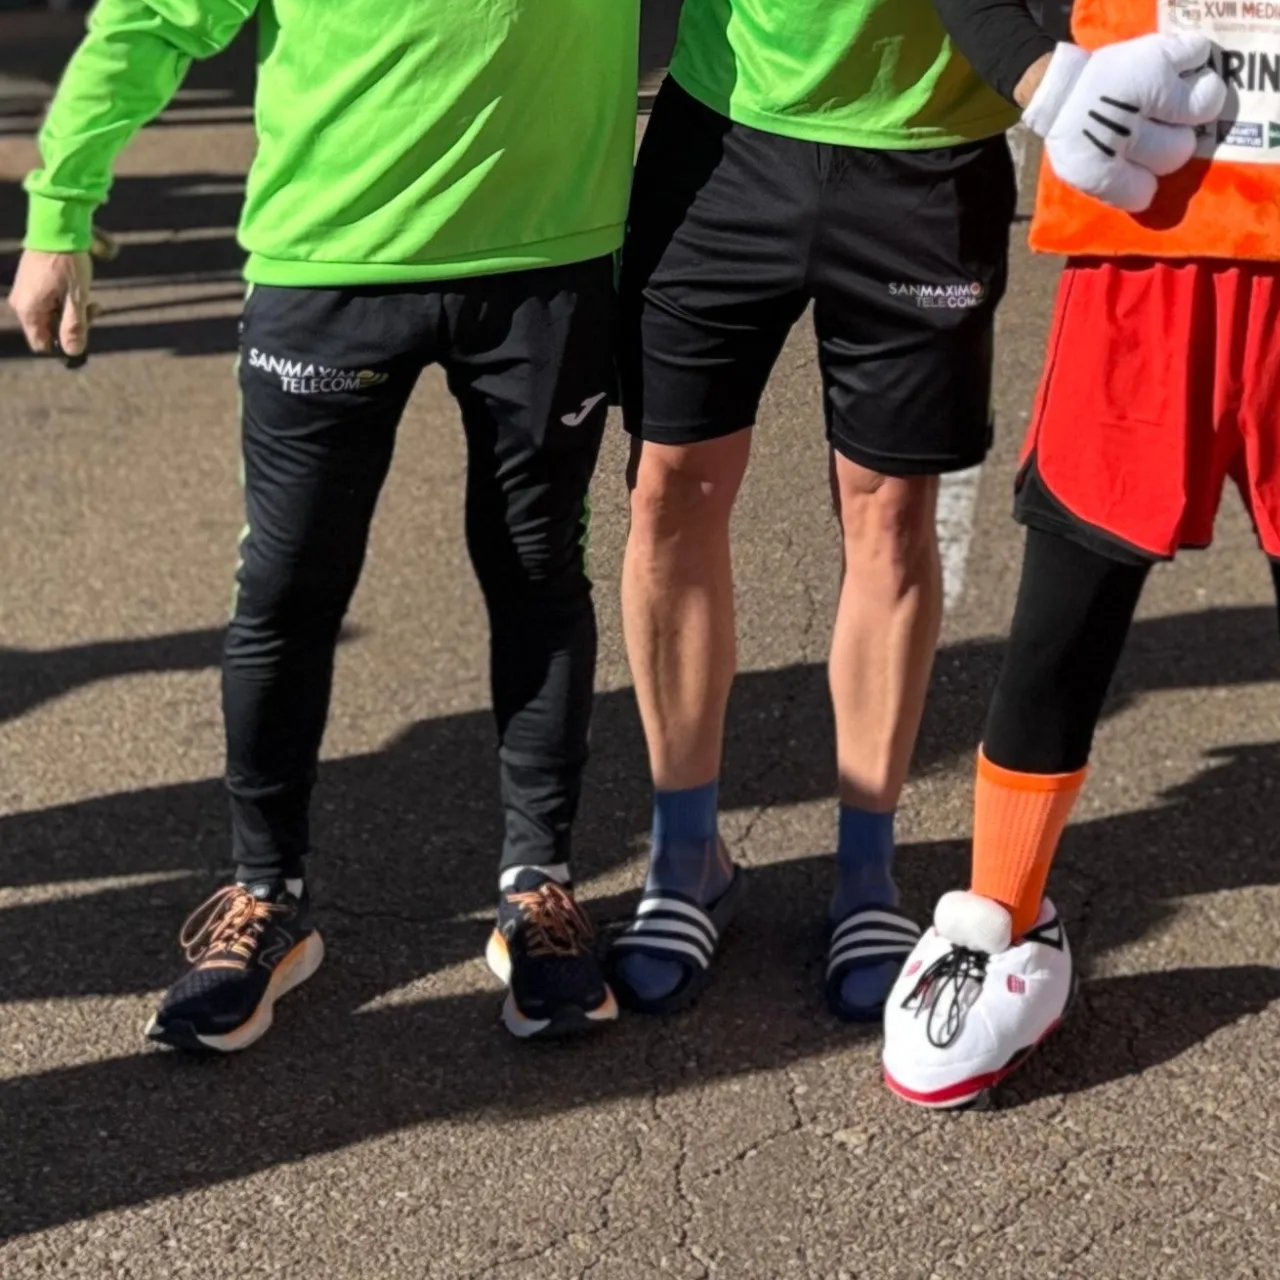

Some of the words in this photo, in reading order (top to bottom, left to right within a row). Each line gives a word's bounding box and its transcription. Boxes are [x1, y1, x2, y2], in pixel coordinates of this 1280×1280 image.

[888, 282, 981, 297] SANMAXIMO
[915, 296, 978, 308] TELECOM
[249, 348, 375, 378] SANMAXIMO
[281, 376, 360, 394] TELECOM
